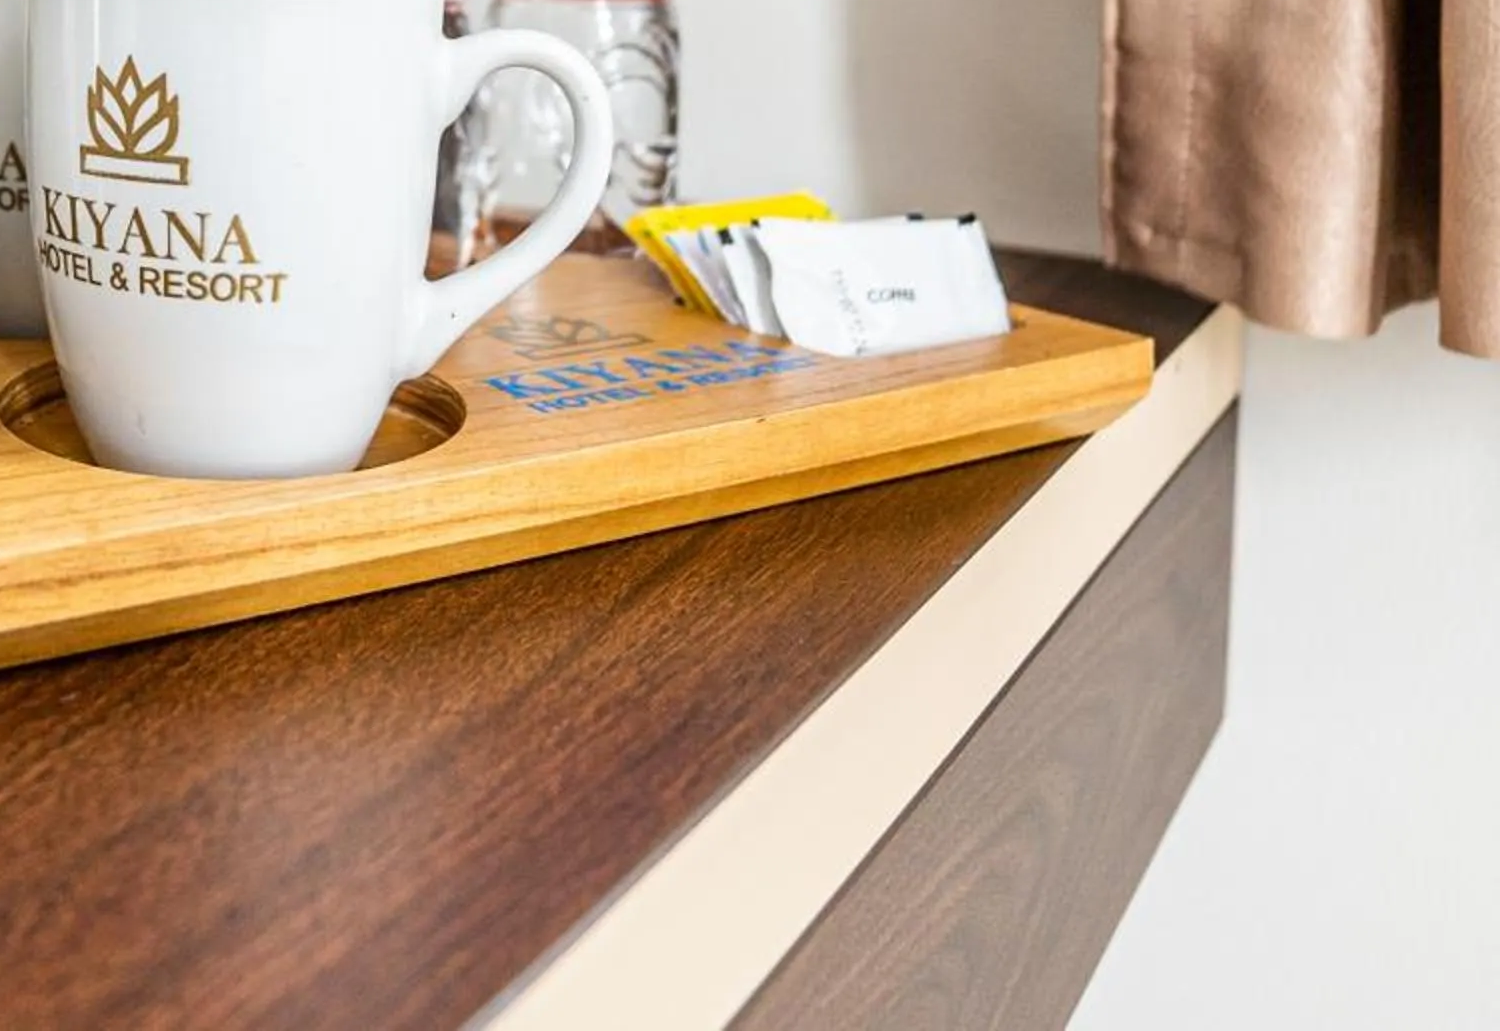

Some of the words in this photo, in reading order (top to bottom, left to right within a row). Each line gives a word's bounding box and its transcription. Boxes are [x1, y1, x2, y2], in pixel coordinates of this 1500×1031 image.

[42, 185, 260, 265] KIYANA
[37, 238, 102, 286] HOTEL
[109, 261, 129, 292] &
[139, 266, 288, 304] RESORT
[484, 341, 785, 399] KIYANA
[526, 386, 657, 414] HOTEL
